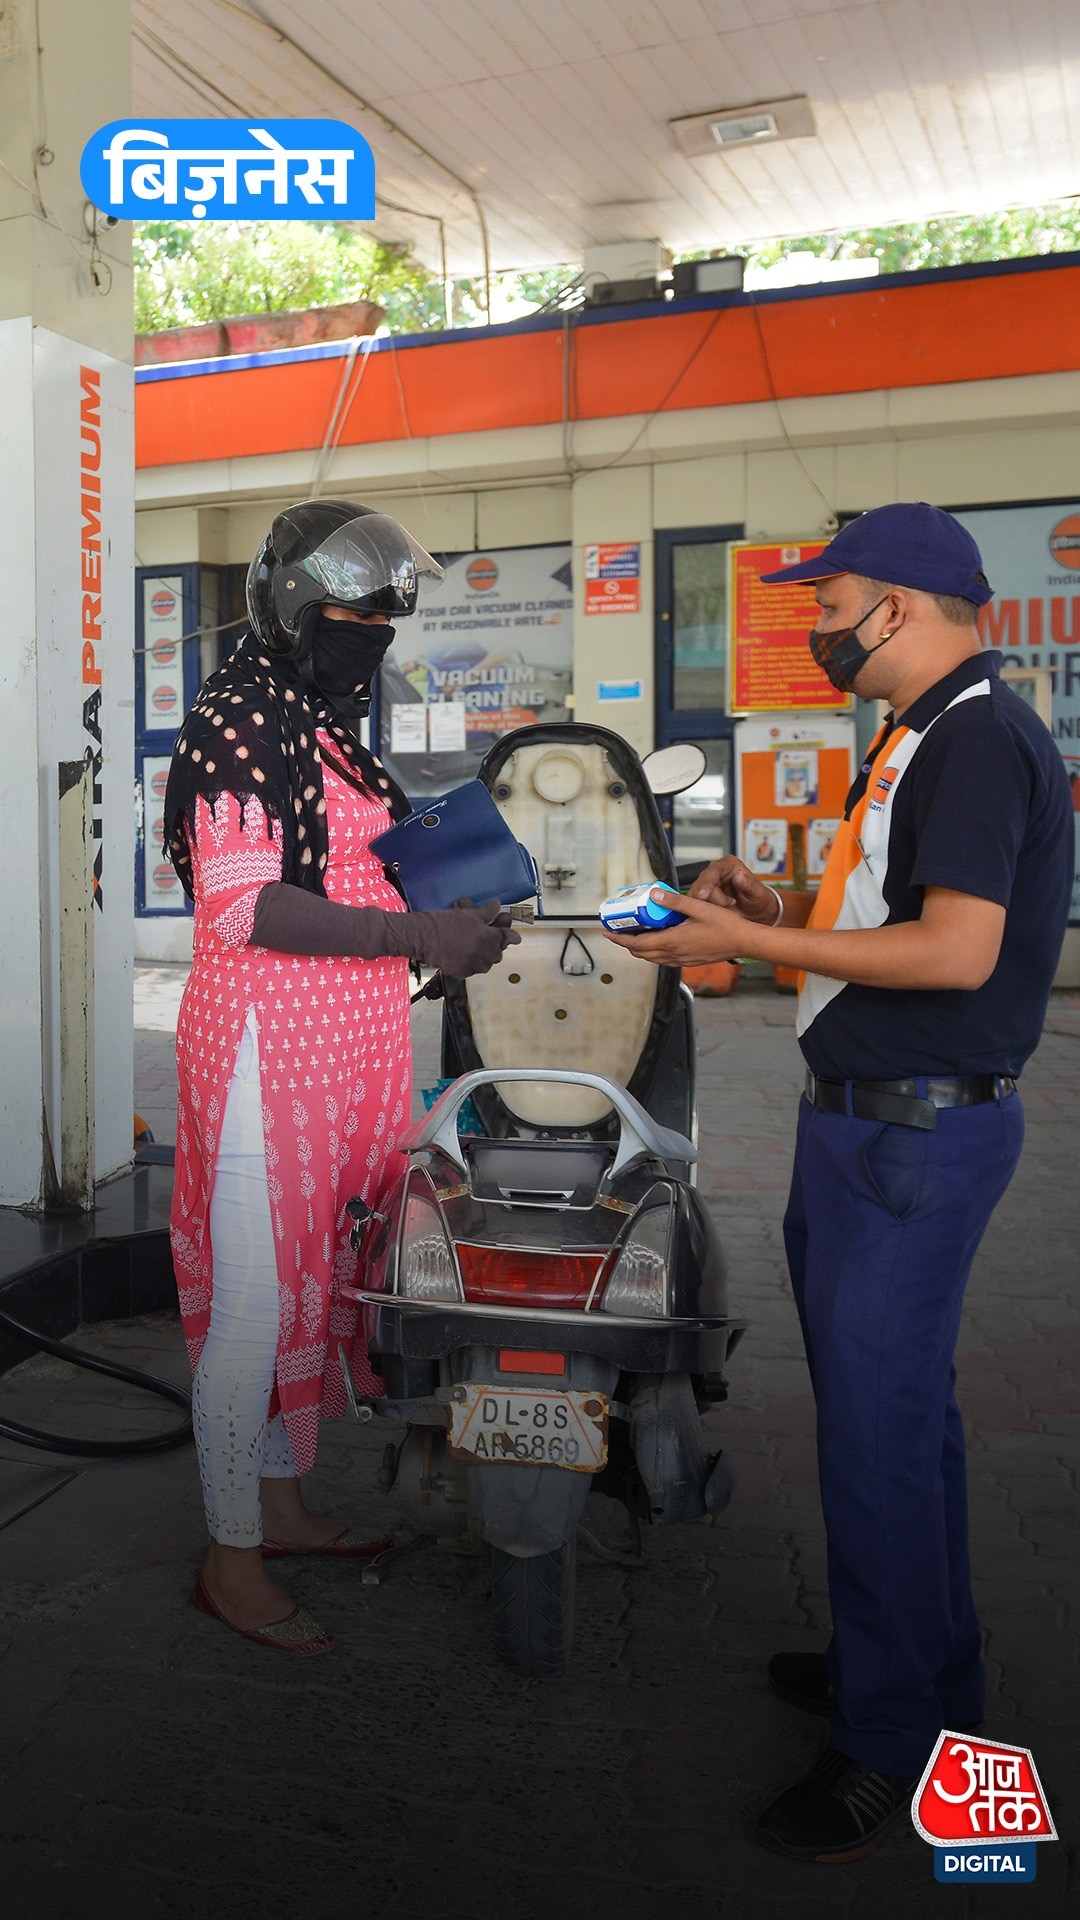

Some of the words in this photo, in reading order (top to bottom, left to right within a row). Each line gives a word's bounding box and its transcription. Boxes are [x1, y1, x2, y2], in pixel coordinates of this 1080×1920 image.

[418, 607, 447, 618] YOUR
[450, 605, 472, 616] CAR
[476, 602, 522, 614] VACUUM
[423, 622, 437, 632] AT
[441, 618, 511, 631] REASONABLE
[433, 666, 536, 687] VACUUM
[422, 689, 546, 707] CLEANING
